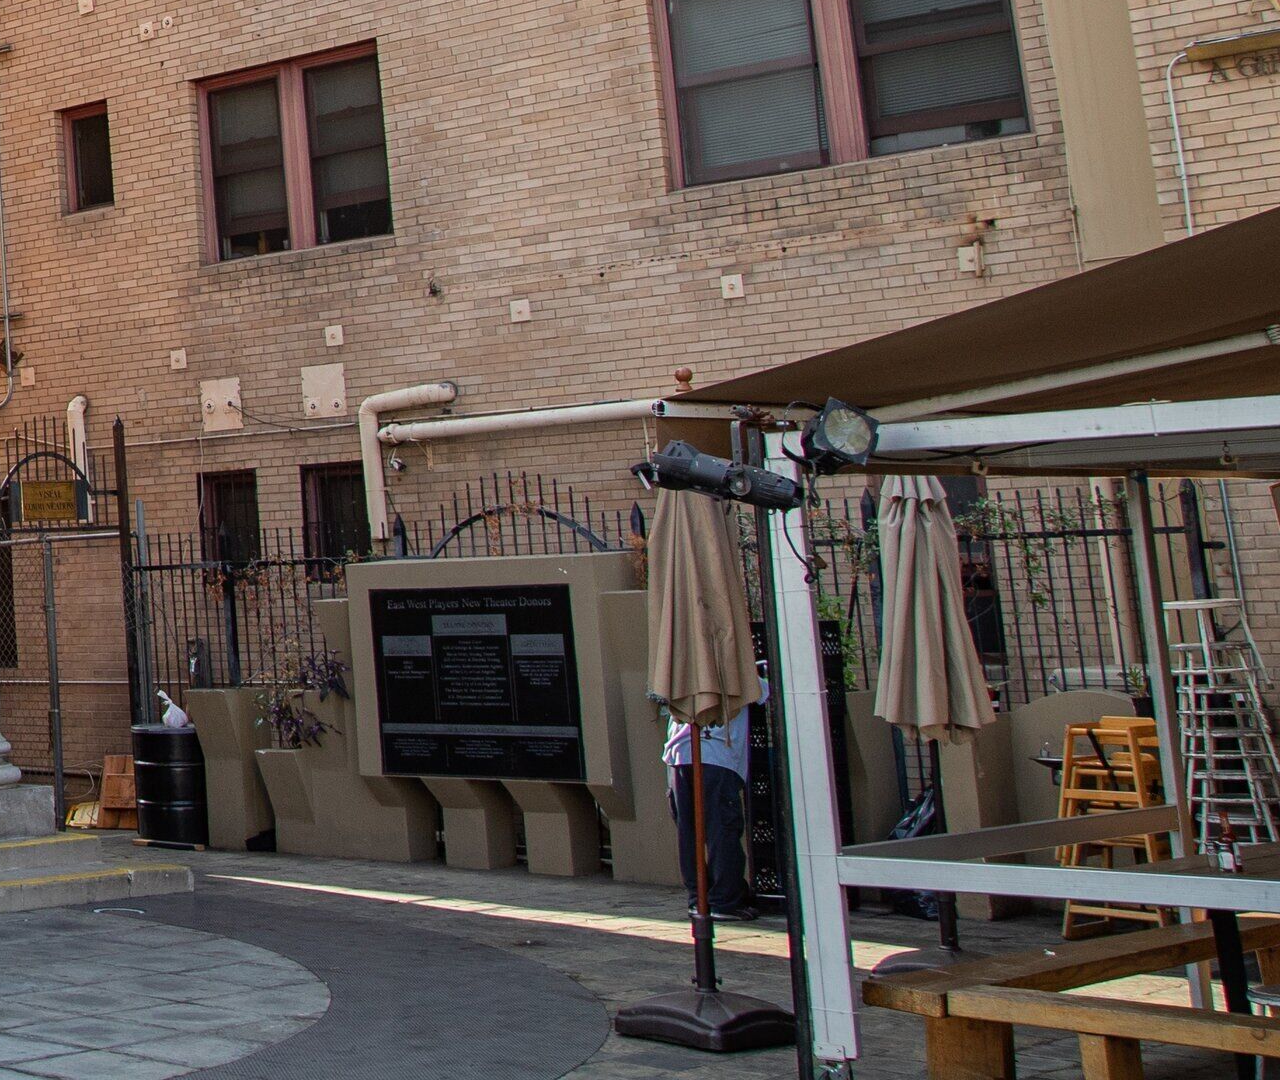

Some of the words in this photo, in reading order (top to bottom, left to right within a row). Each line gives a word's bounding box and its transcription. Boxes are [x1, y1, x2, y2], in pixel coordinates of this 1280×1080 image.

[387, 599, 405, 610] East
[406, 599, 427, 609] West
[429, 598, 459, 611] Players
[519, 596, 552, 607] Donors
